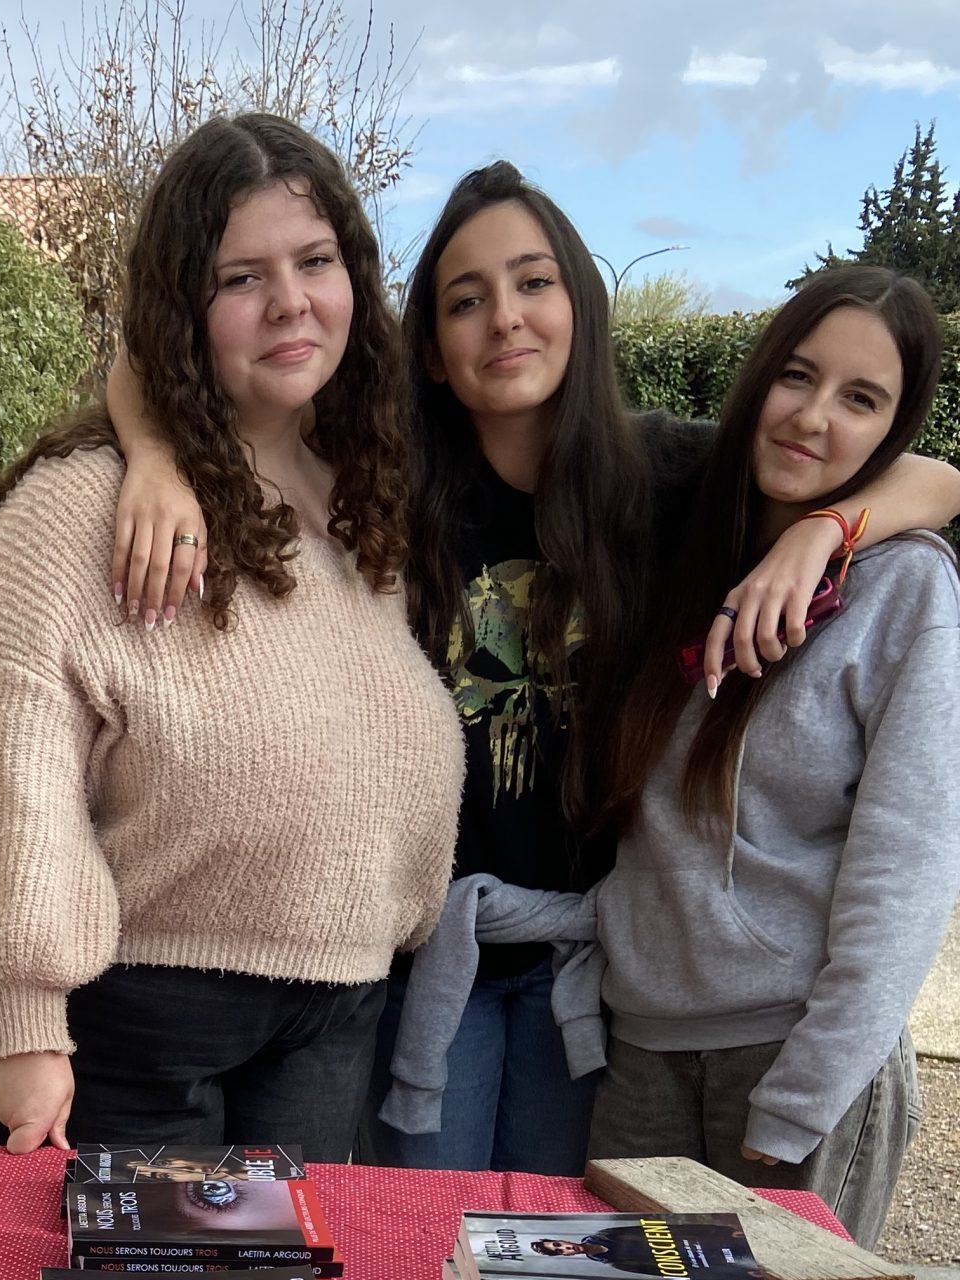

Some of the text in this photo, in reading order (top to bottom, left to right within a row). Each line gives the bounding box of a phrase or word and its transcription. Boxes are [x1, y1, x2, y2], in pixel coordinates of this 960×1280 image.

[102, 1192, 112, 1209] SERONS
[119, 1191, 138, 1214] TROIS
[96, 1209, 115, 1230] NOUS
[90, 1246, 218, 1257] NOUS SERONS TOUJOURS TROIS
[496, 1228, 524, 1262] ARGOUD
[238, 1250, 312, 1260] LAETITIA ARGOUD
[102, 1263, 228, 1272] NOUS SERONS TOUJOURS TROIS
